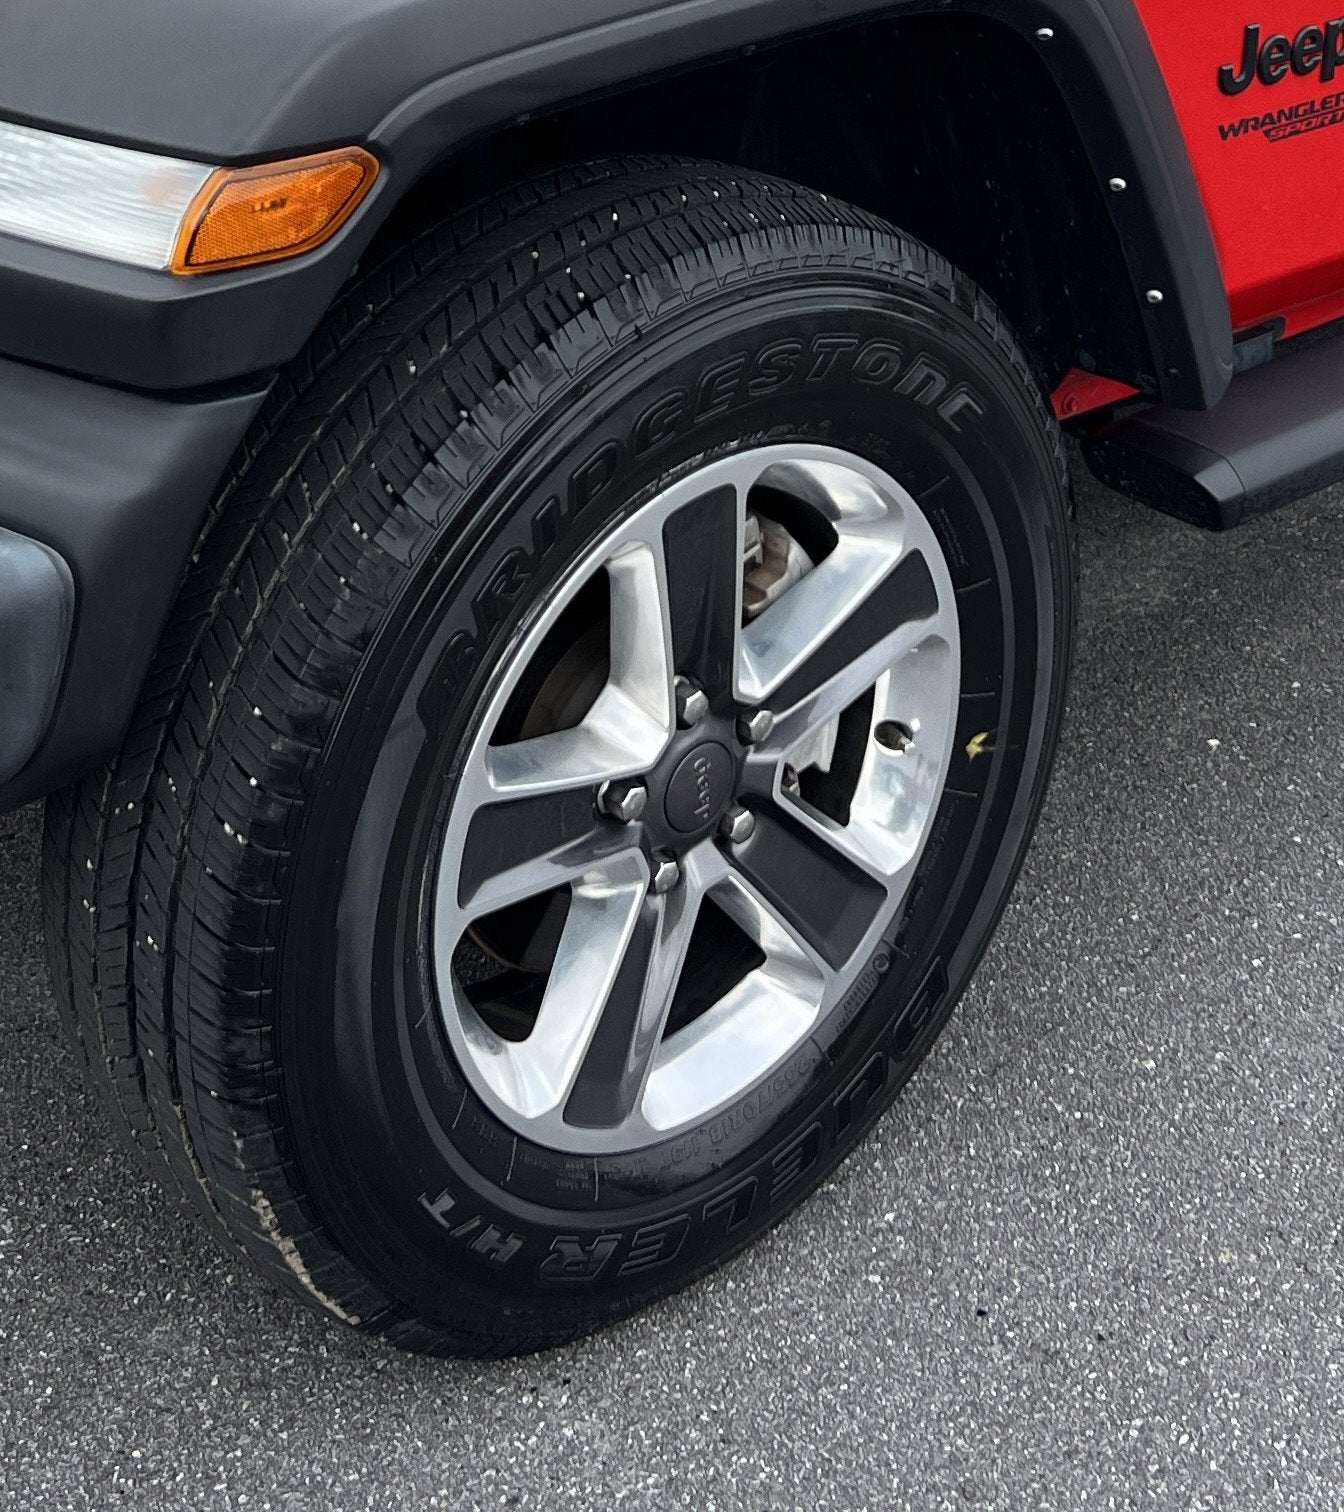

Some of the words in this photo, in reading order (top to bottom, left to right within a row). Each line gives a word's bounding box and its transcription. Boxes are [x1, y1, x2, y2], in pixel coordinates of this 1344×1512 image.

[416, 330, 989, 750] BRIDGESTONE
[417, 1186, 527, 1265] H/T
[535, 955, 950, 1282] DUELER
